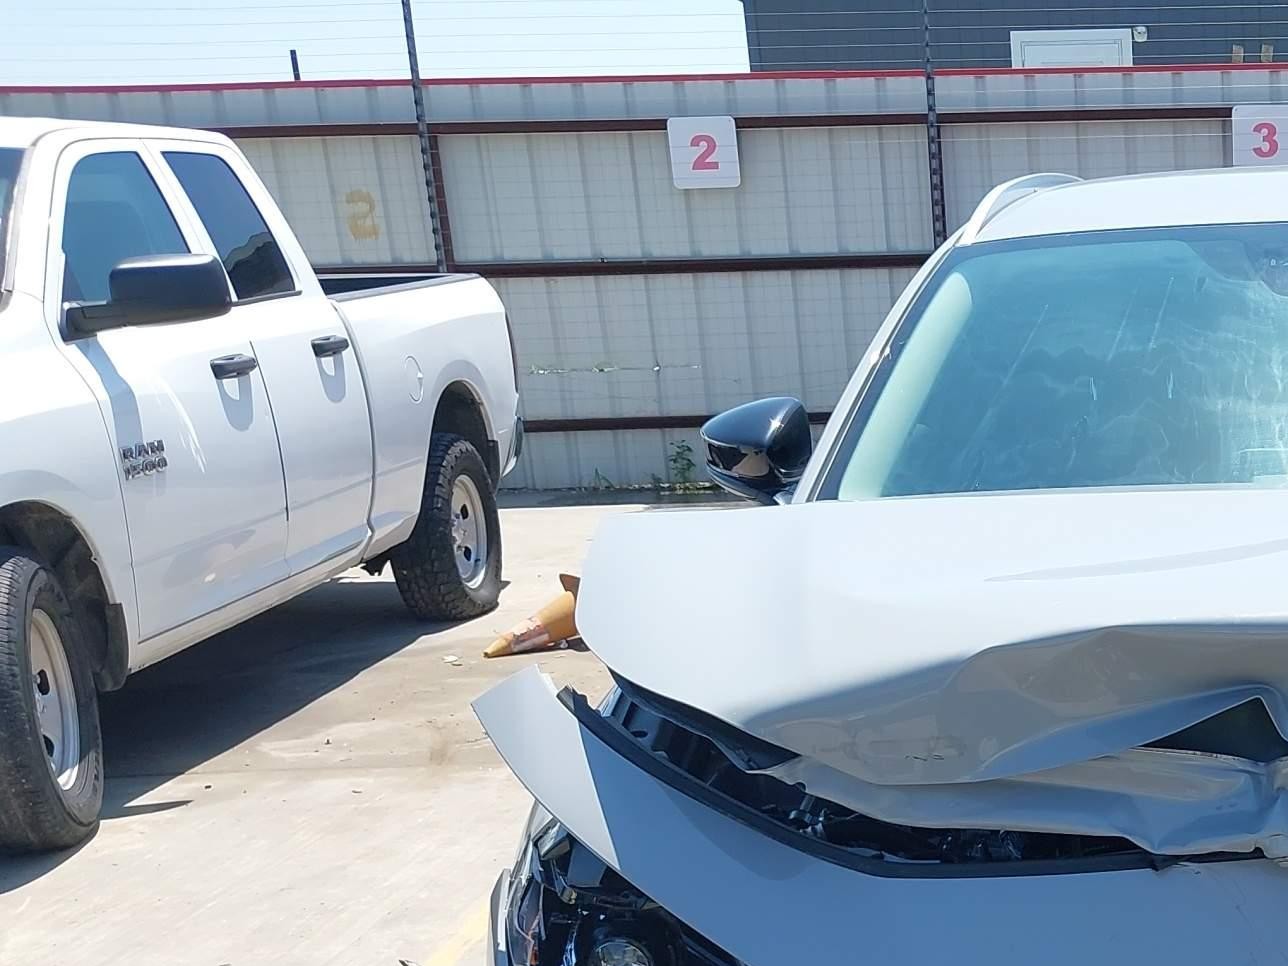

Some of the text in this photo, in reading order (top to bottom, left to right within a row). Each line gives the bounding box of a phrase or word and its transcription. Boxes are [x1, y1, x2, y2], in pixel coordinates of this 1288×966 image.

[689, 134, 720, 171] 2
[1252, 122, 1279, 158] 3
[344, 190, 379, 240] 2
[119, 440, 165, 464] RAM
[123, 455, 168, 480] 1500
